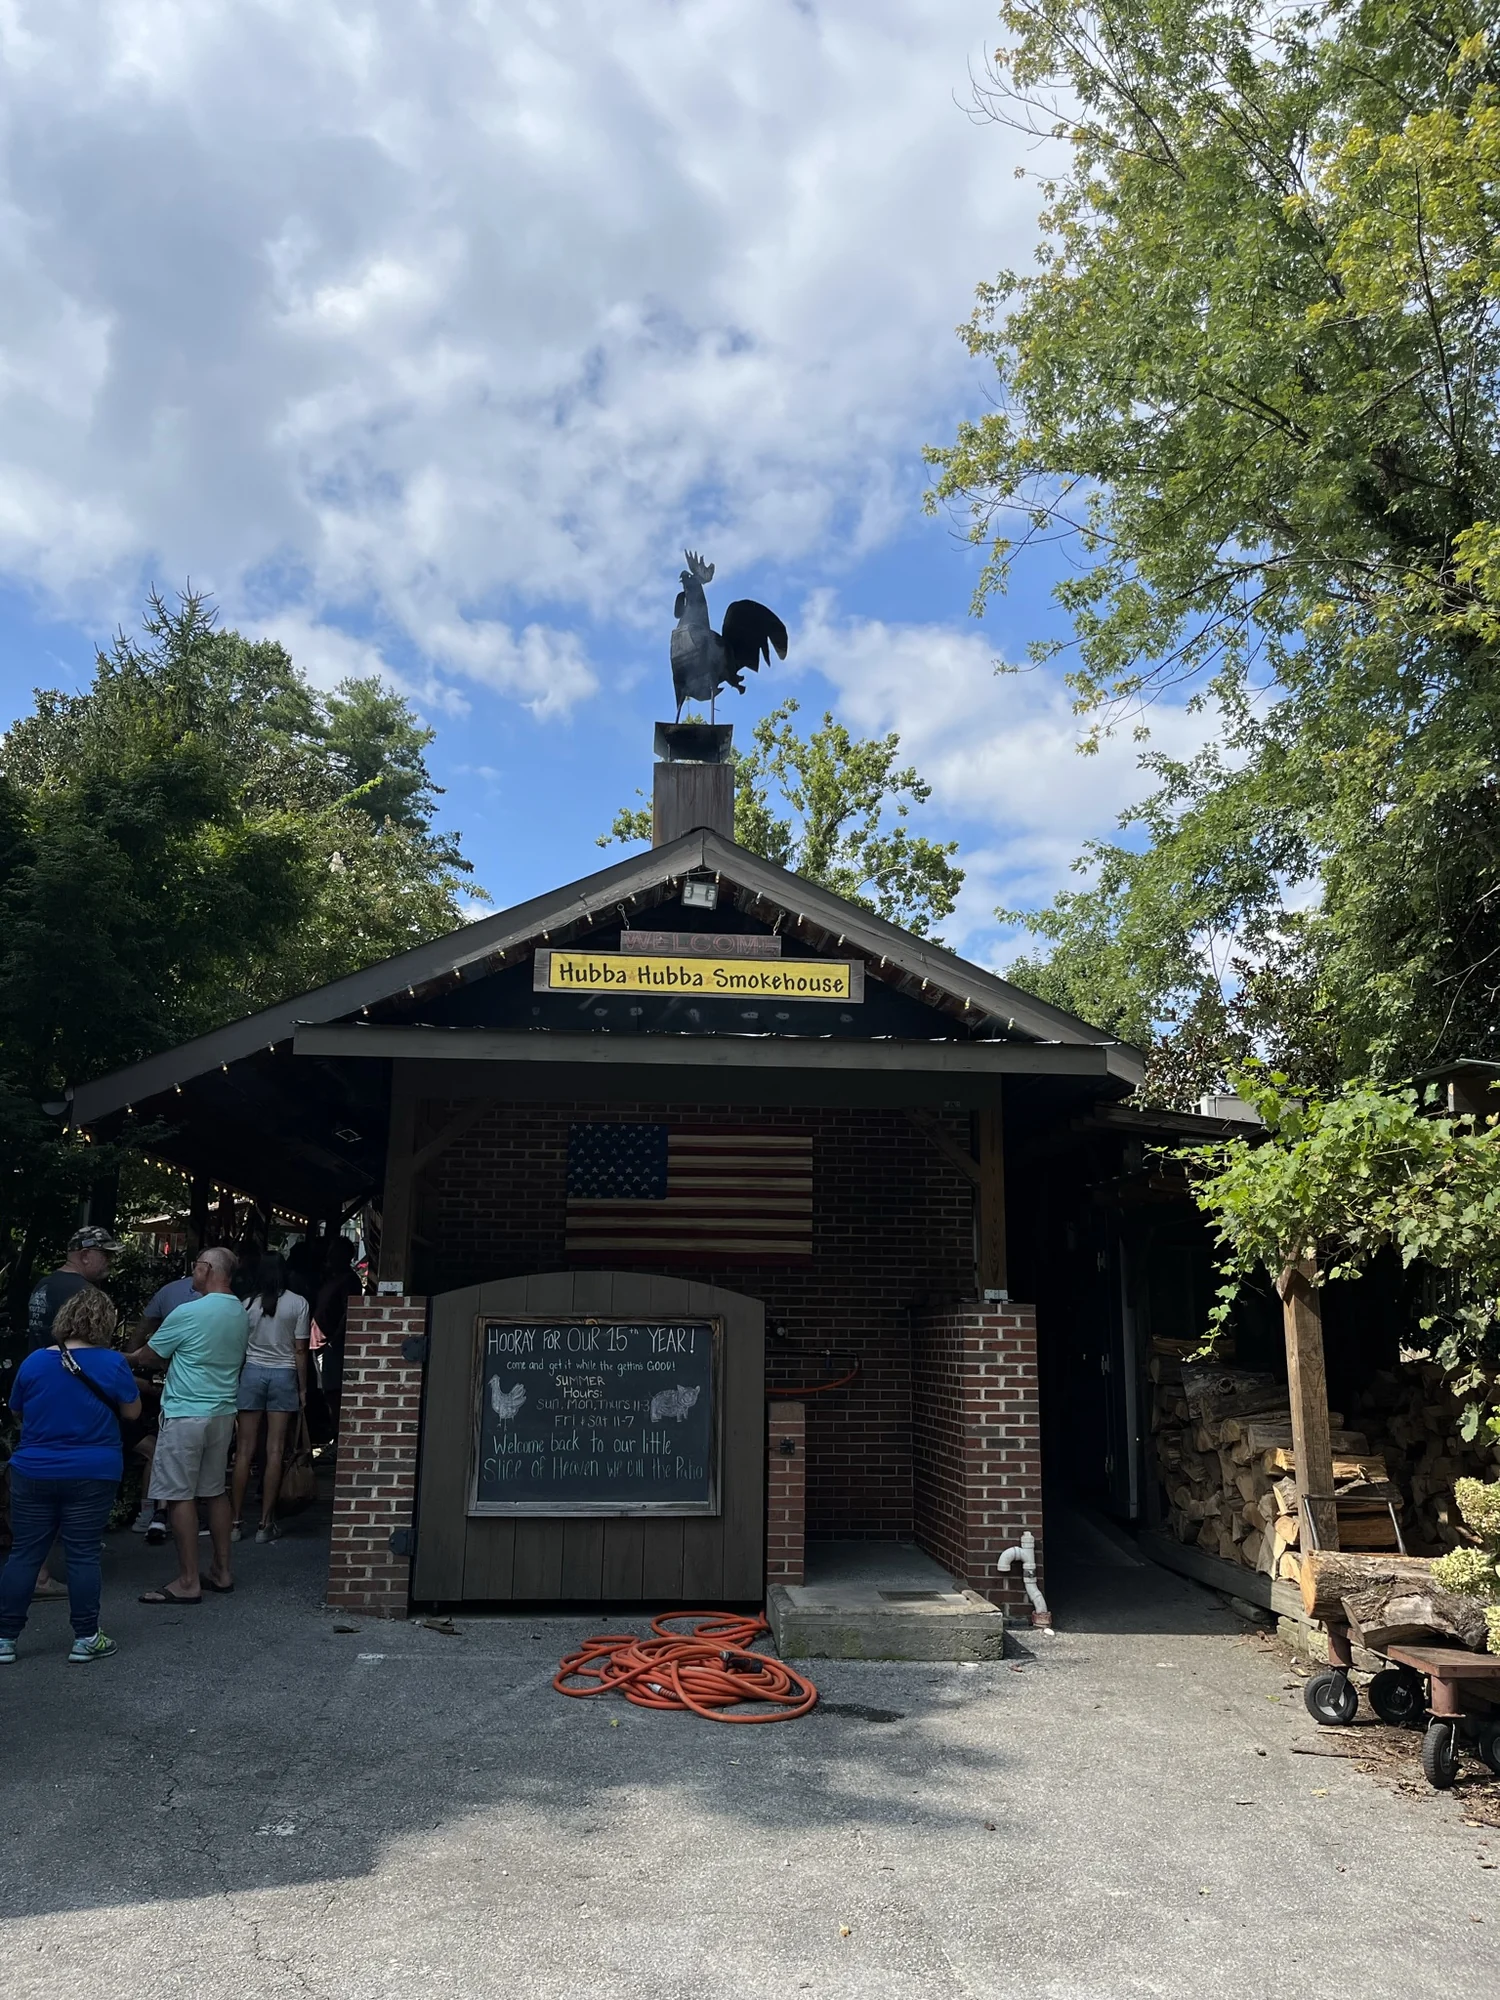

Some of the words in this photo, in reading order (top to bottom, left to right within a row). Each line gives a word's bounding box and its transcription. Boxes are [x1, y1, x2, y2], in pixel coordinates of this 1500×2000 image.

[624, 932, 780, 955] WELCOME
[559, 962, 627, 984] Hubba
[637, 965, 704, 987] Hubba
[712, 968, 845, 993] Smokehouse
[488, 1328, 537, 1355] HOORAY
[543, 1329, 562, 1350] FOR
[567, 1327, 600, 1352] OUR
[606, 1326, 639, 1352] 15th
[646, 1326, 695, 1353] YEAR!
[506, 1361, 526, 1370] come
[529, 1358, 544, 1370] and
[549, 1359, 562, 1376] get
[564, 1359, 571, 1370] it
[576, 1359, 596, 1370] while
[600, 1360, 613, 1371] the
[646, 1360, 676, 1371] GOOD!
[555, 1375, 606, 1387] SUMMER
[563, 1387, 603, 1398] Hours:
[555, 1414, 576, 1427] Fri
[587, 1415, 608, 1427] Sat
[613, 1415, 634, 1428] 11-7
[493, 1432, 545, 1454] Welcome
[550, 1429, 580, 1452] back
[590, 1430, 604, 1453] to
[613, 1438, 636, 1453] our
[642, 1429, 672, 1454] little
[483, 1458, 522, 1481] Slice
[531, 1456, 546, 1479] of
[553, 1456, 599, 1480] Heaven
[652, 1457, 672, 1480] the
[676, 1456, 703, 1480] Patio
